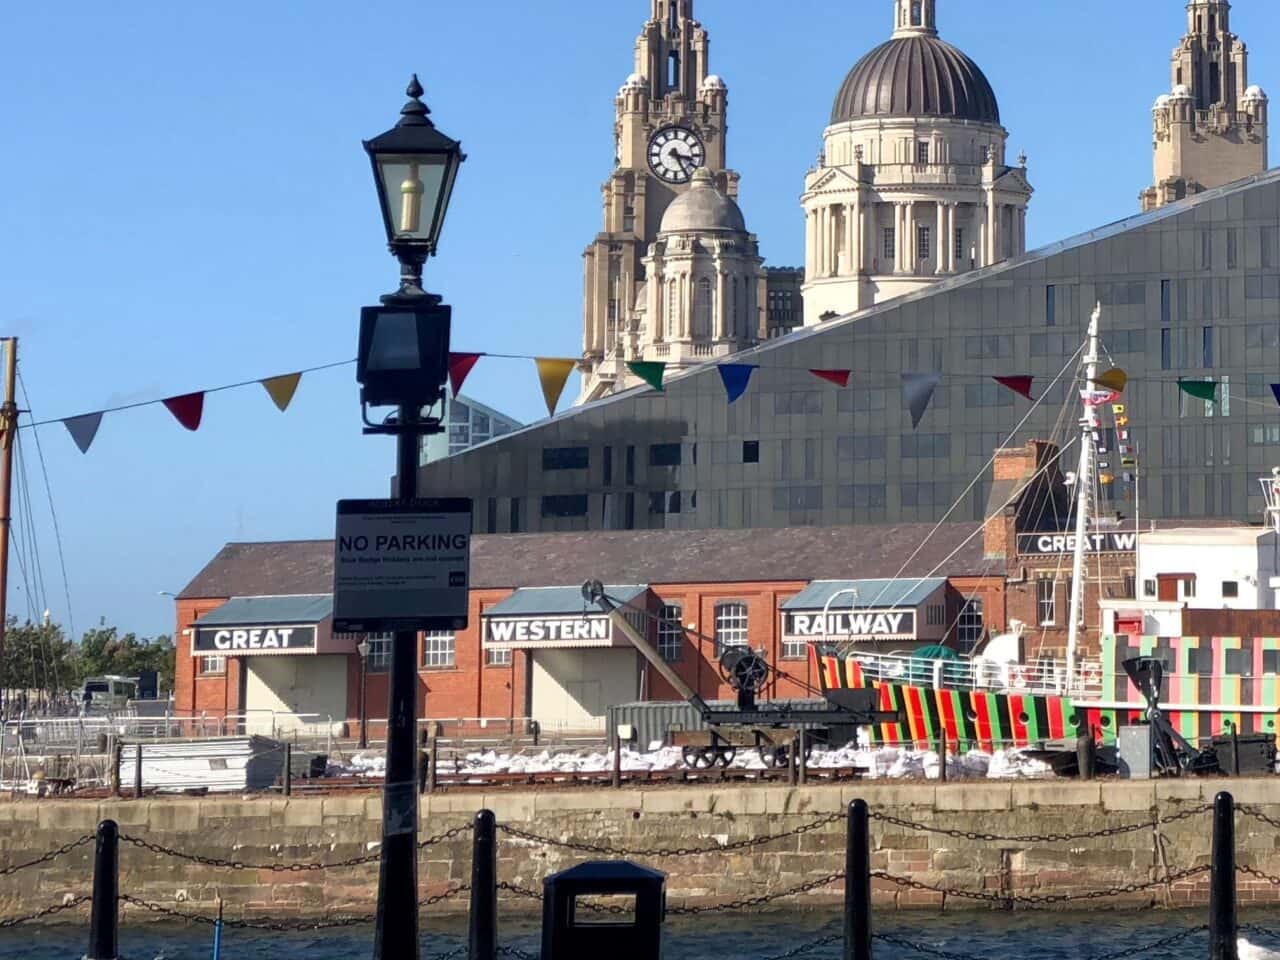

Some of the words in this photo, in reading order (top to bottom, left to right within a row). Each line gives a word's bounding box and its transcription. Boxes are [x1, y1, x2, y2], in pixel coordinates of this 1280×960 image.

[340, 536, 369, 552] NO
[376, 534, 467, 551] PARKING
[490, 619, 607, 641] WESTERN
[794, 613, 903, 635] RAILWAY
[214, 629, 294, 649] GREAT
